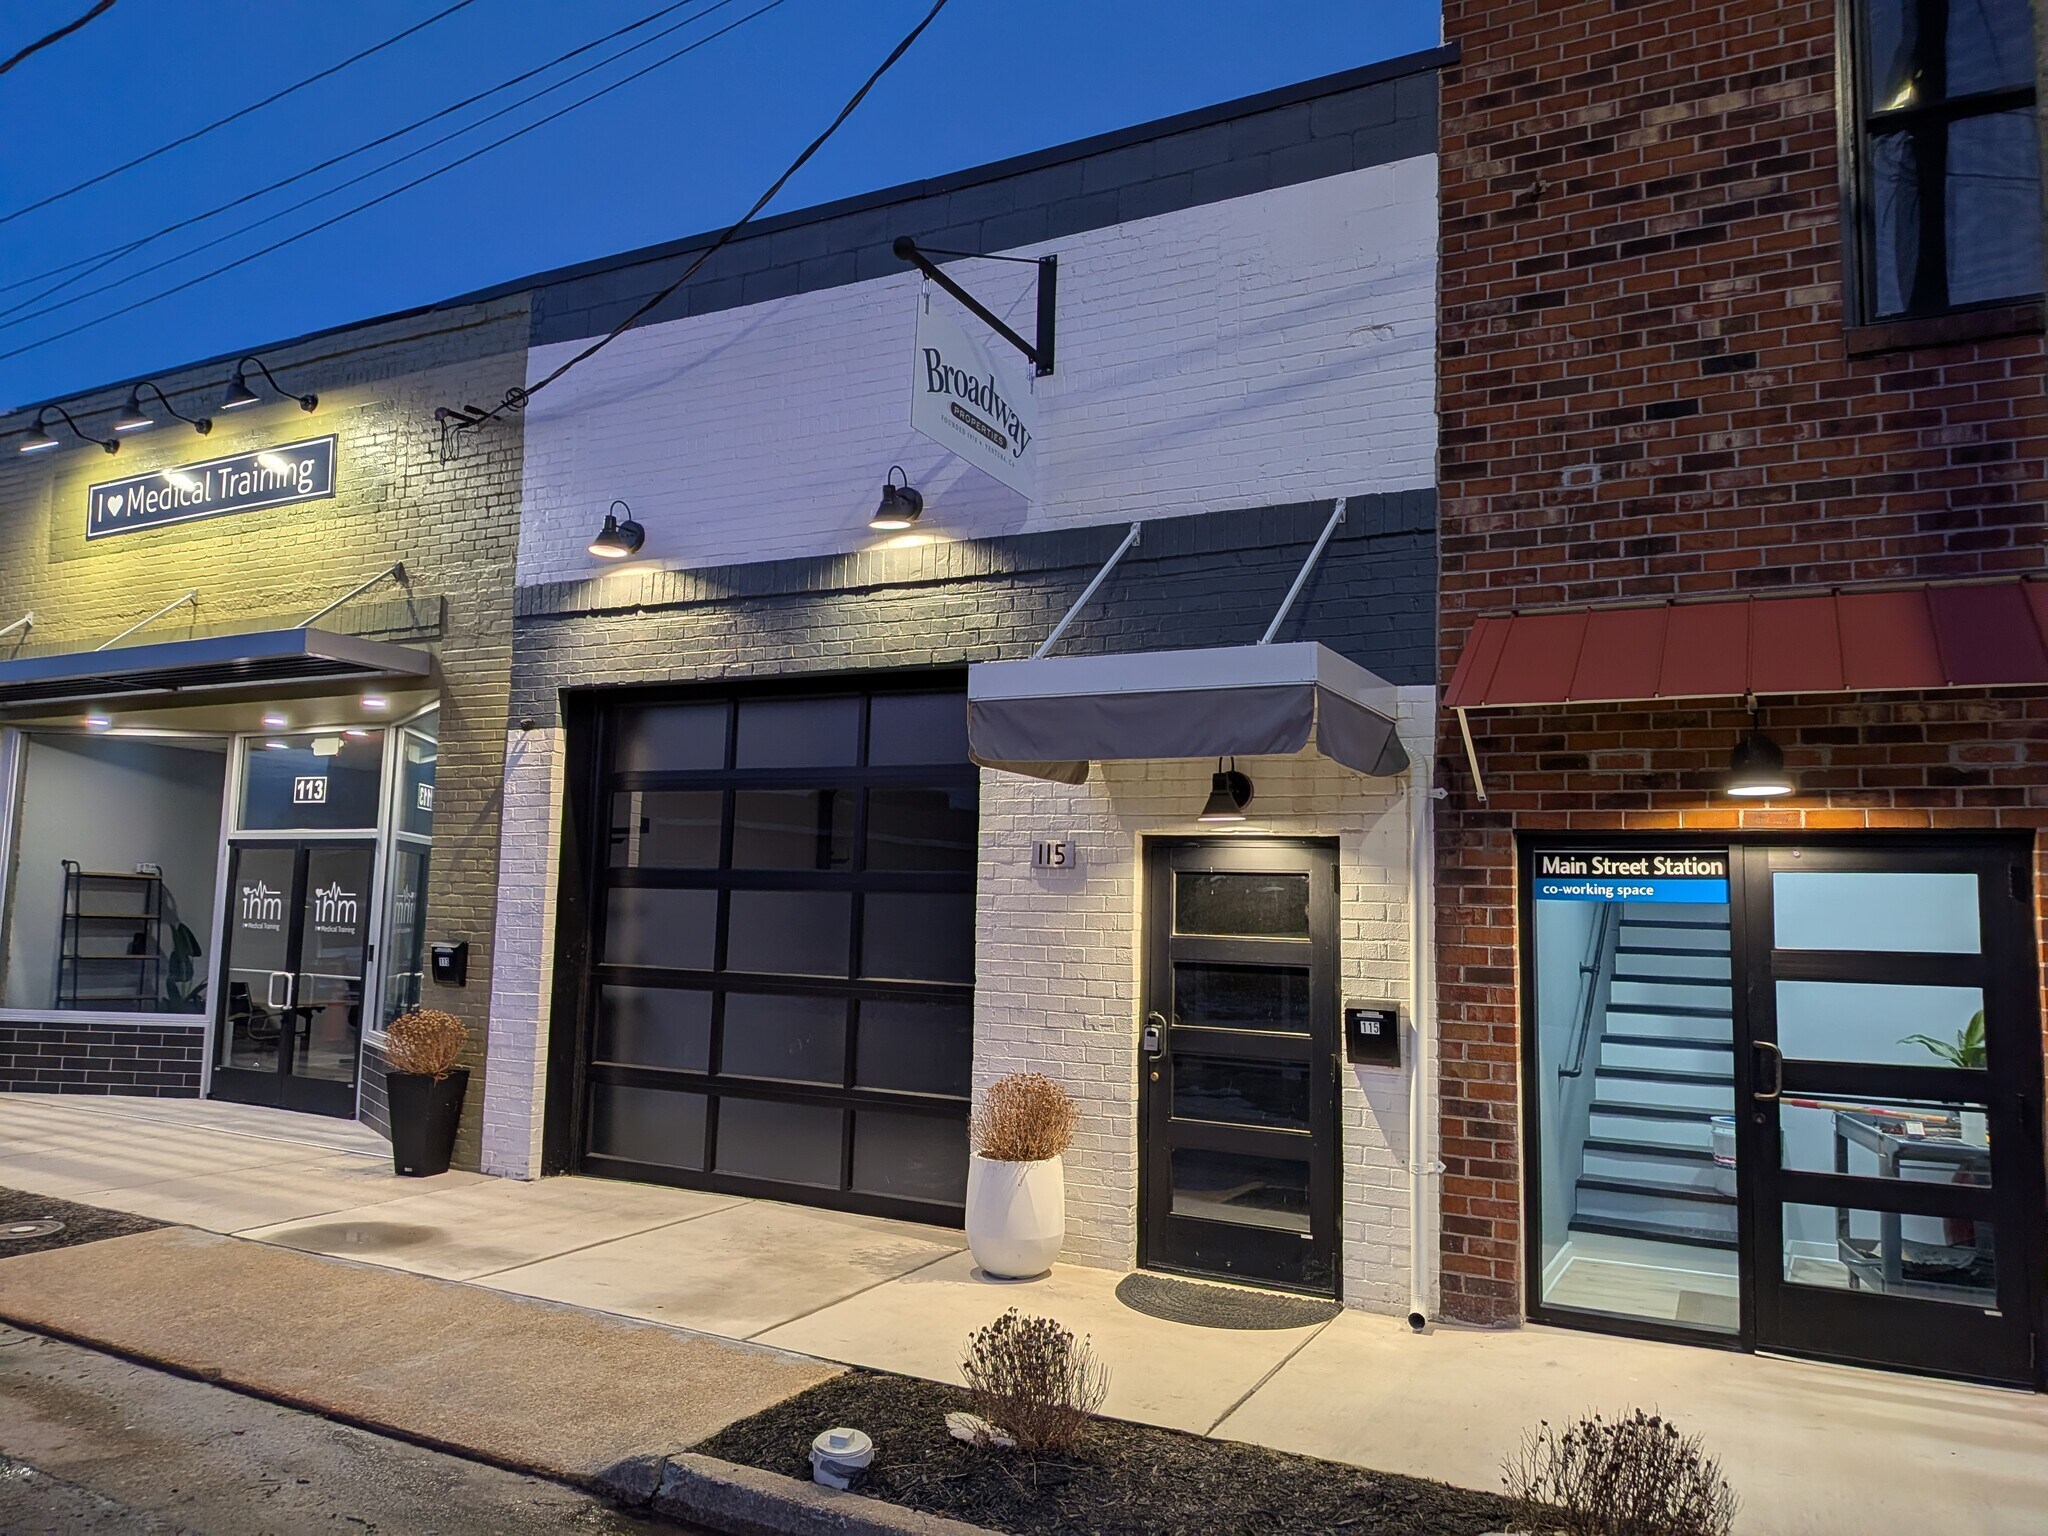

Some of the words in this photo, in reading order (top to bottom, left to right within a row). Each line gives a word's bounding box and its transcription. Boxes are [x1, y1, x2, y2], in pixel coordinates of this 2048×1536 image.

[922, 348, 1033, 458] Broadway
[953, 406, 1004, 446] PROPERTIES
[98, 494, 103, 523] I
[127, 471, 211, 517] Medical
[218, 459, 315, 494] Training
[298, 780, 323, 800] 113
[1039, 844, 1066, 865] 115
[1542, 856, 1587, 875] Main
[1591, 856, 1649, 875] Street
[1653, 856, 1723, 875] Station
[1543, 883, 1614, 898] co-working
[1617, 886, 1654, 898] space
[338, 926, 355, 935] Training
[1362, 1022, 1379, 1033] 115
